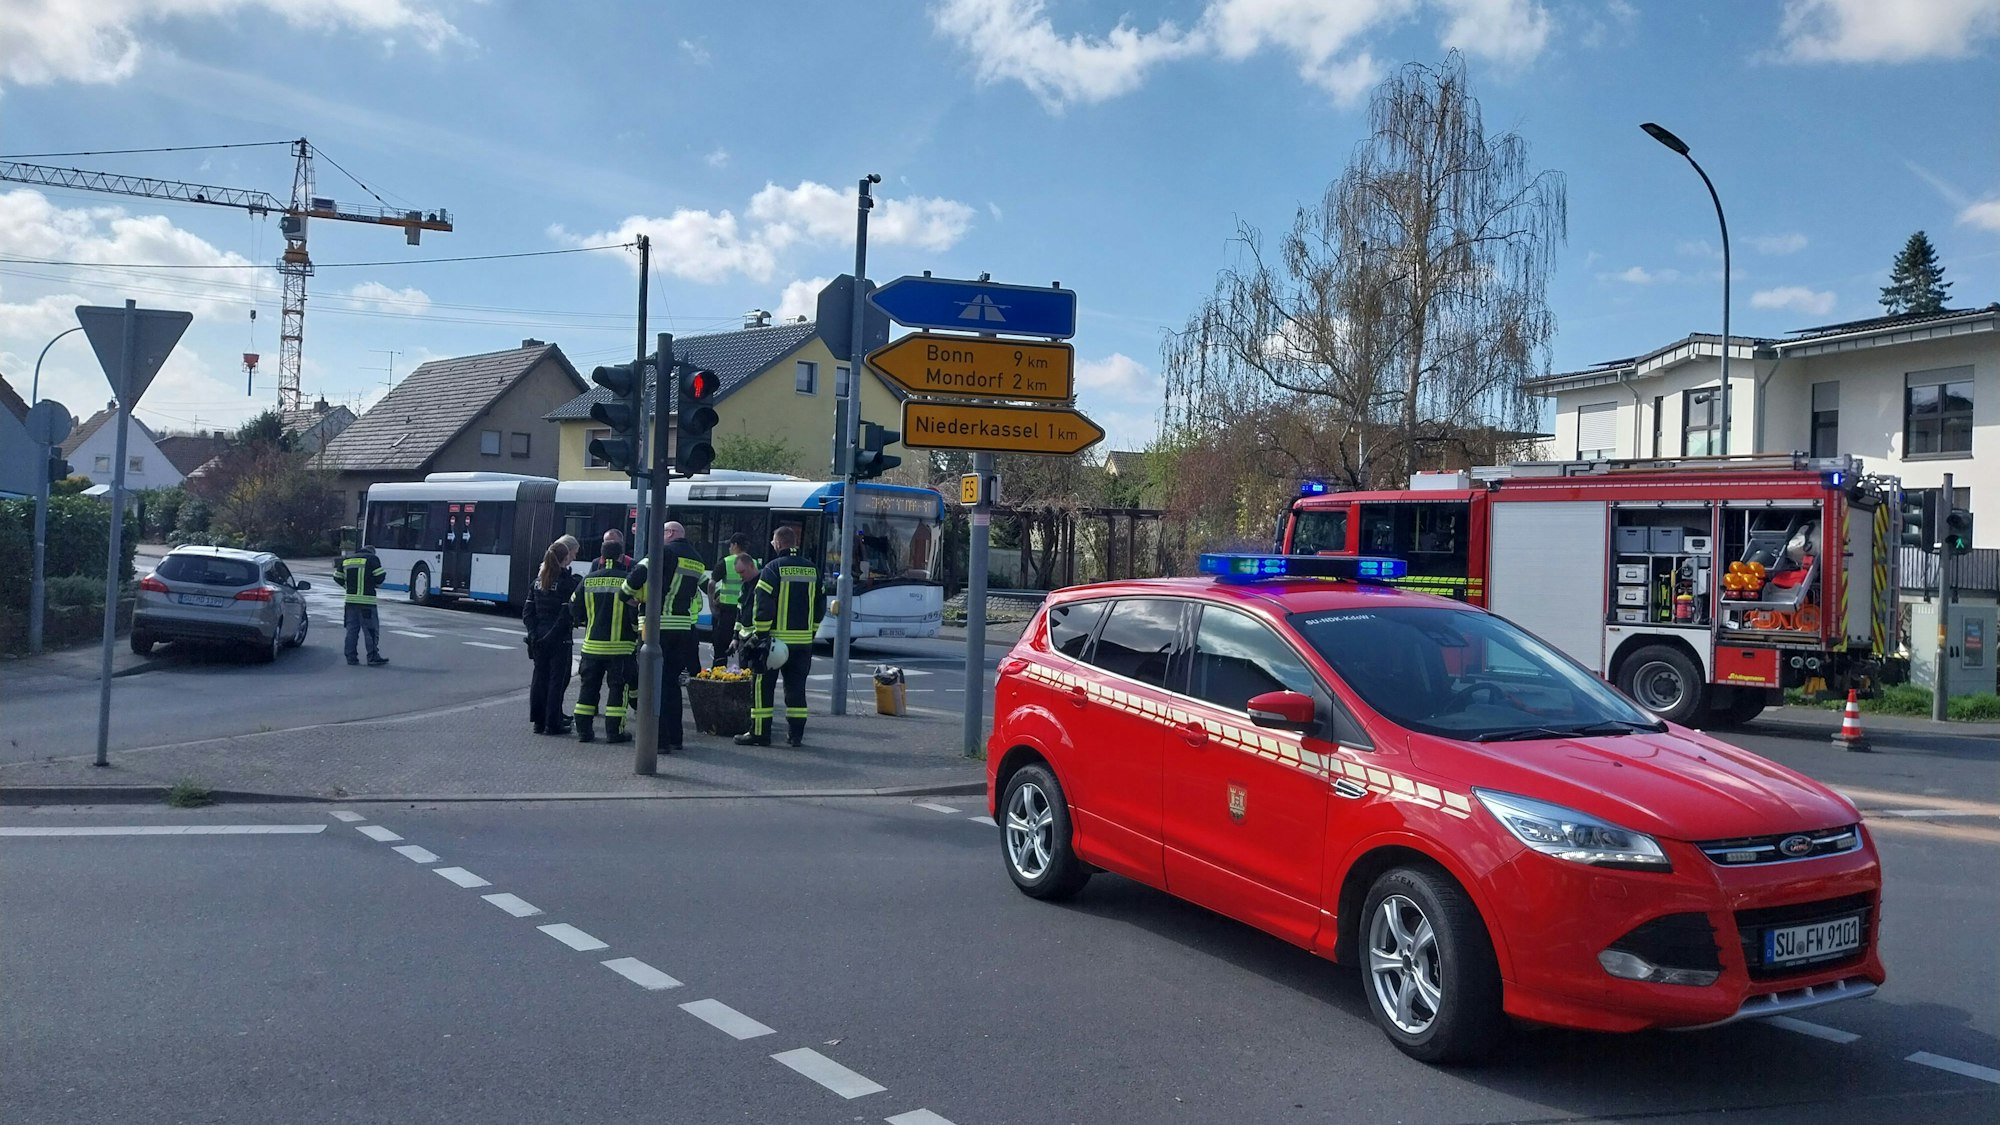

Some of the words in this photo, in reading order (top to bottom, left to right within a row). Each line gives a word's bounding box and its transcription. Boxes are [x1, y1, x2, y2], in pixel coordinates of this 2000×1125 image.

[927, 344, 974, 364] Bonn
[1013, 350, 1023, 367] 9
[1028, 355, 1048, 369] km
[926, 367, 1004, 389] Mondorf
[1012, 373, 1023, 390] 2
[1026, 378, 1047, 391] km
[916, 415, 1039, 440] Niederkassel
[1048, 423, 1054, 440] 1
[1057, 427, 1078, 441] km
[964, 480, 975, 499] FS
[585, 578, 624, 587] FEUERWEHR
[780, 567, 816, 577] FEUERWEHR
[1775, 931, 1795, 958] SU
[1806, 927, 1824, 953] FW
[1828, 920, 1857, 949] 9101
